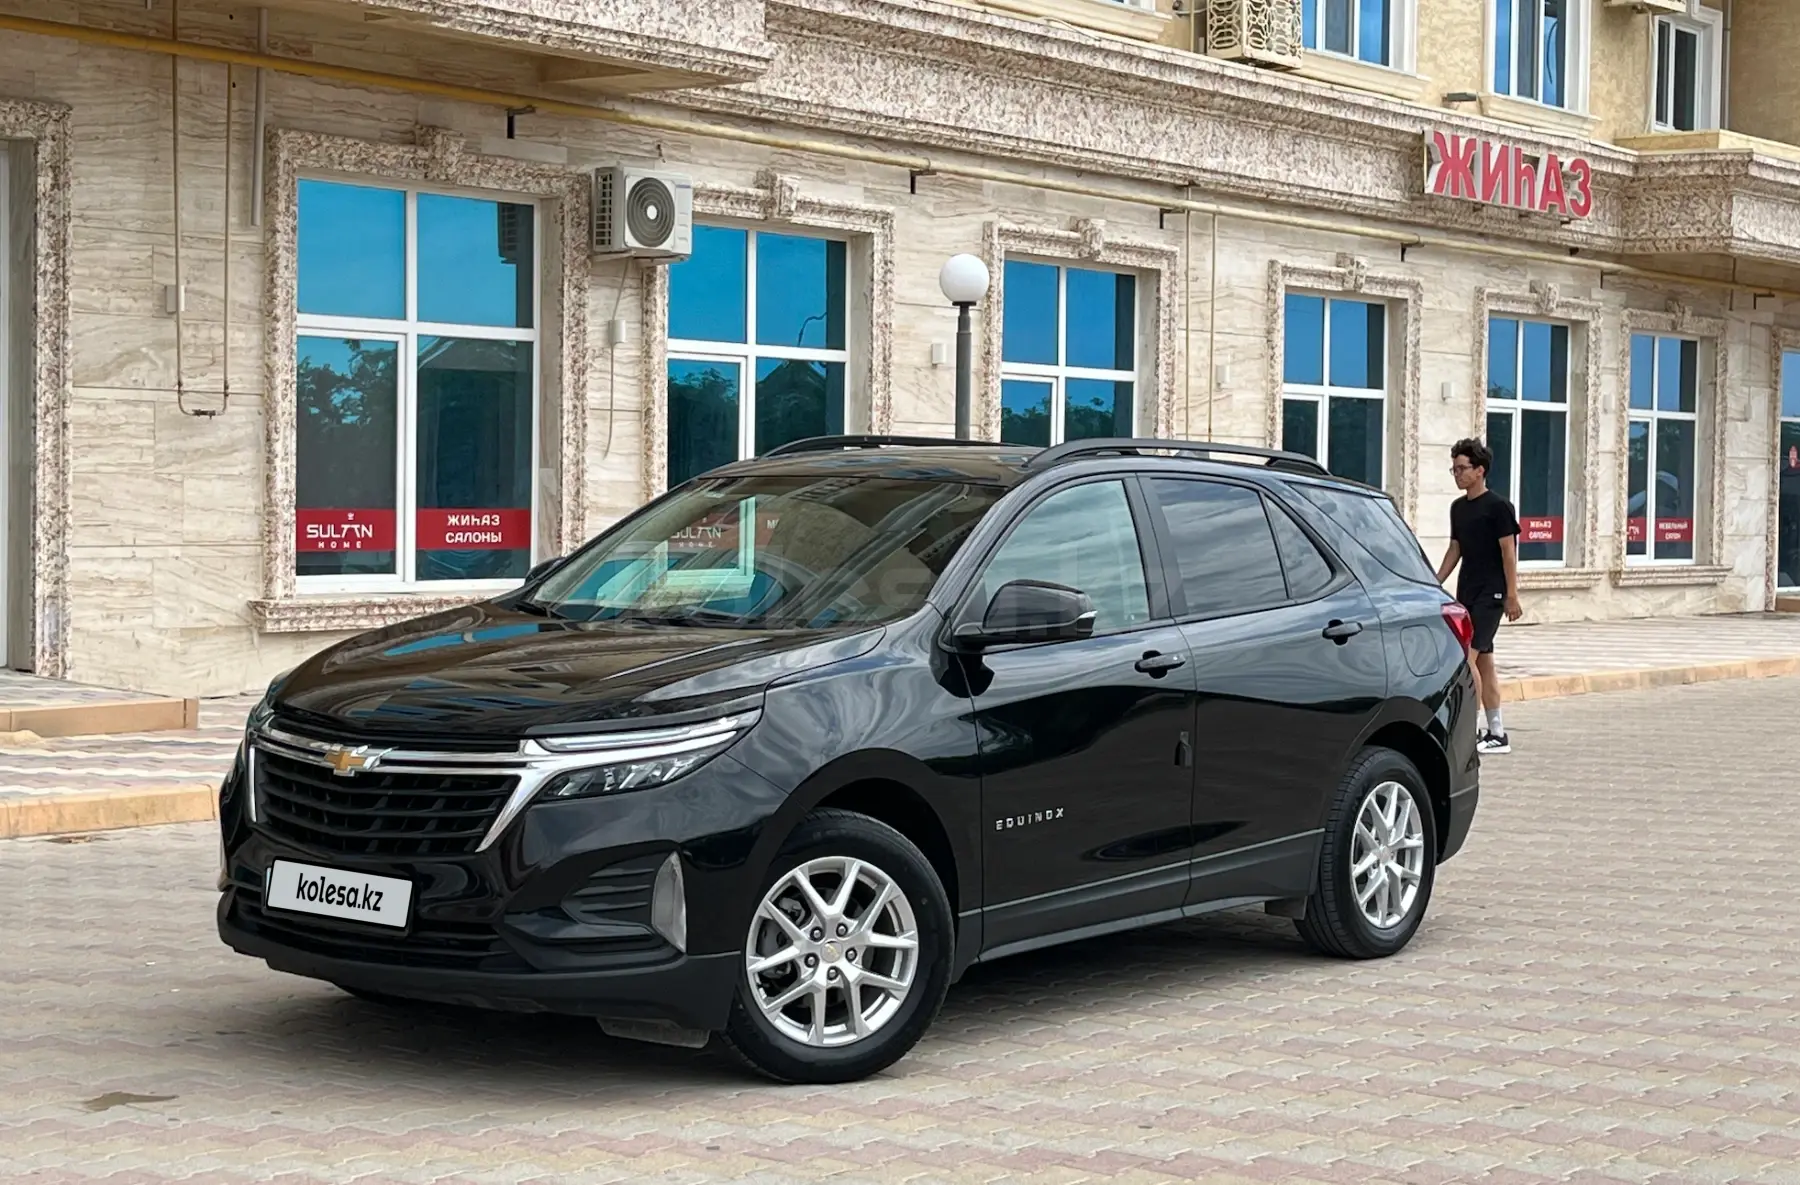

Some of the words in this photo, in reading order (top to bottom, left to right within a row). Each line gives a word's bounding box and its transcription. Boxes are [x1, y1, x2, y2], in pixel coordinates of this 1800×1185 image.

[1429, 130, 1592, 217] ЖИҺАЗ
[306, 524, 373, 538] SULTAN
[445, 531, 502, 544] САЛОНЫ
[318, 541, 363, 549] HOME
[995, 808, 1064, 831] EQUINOX
